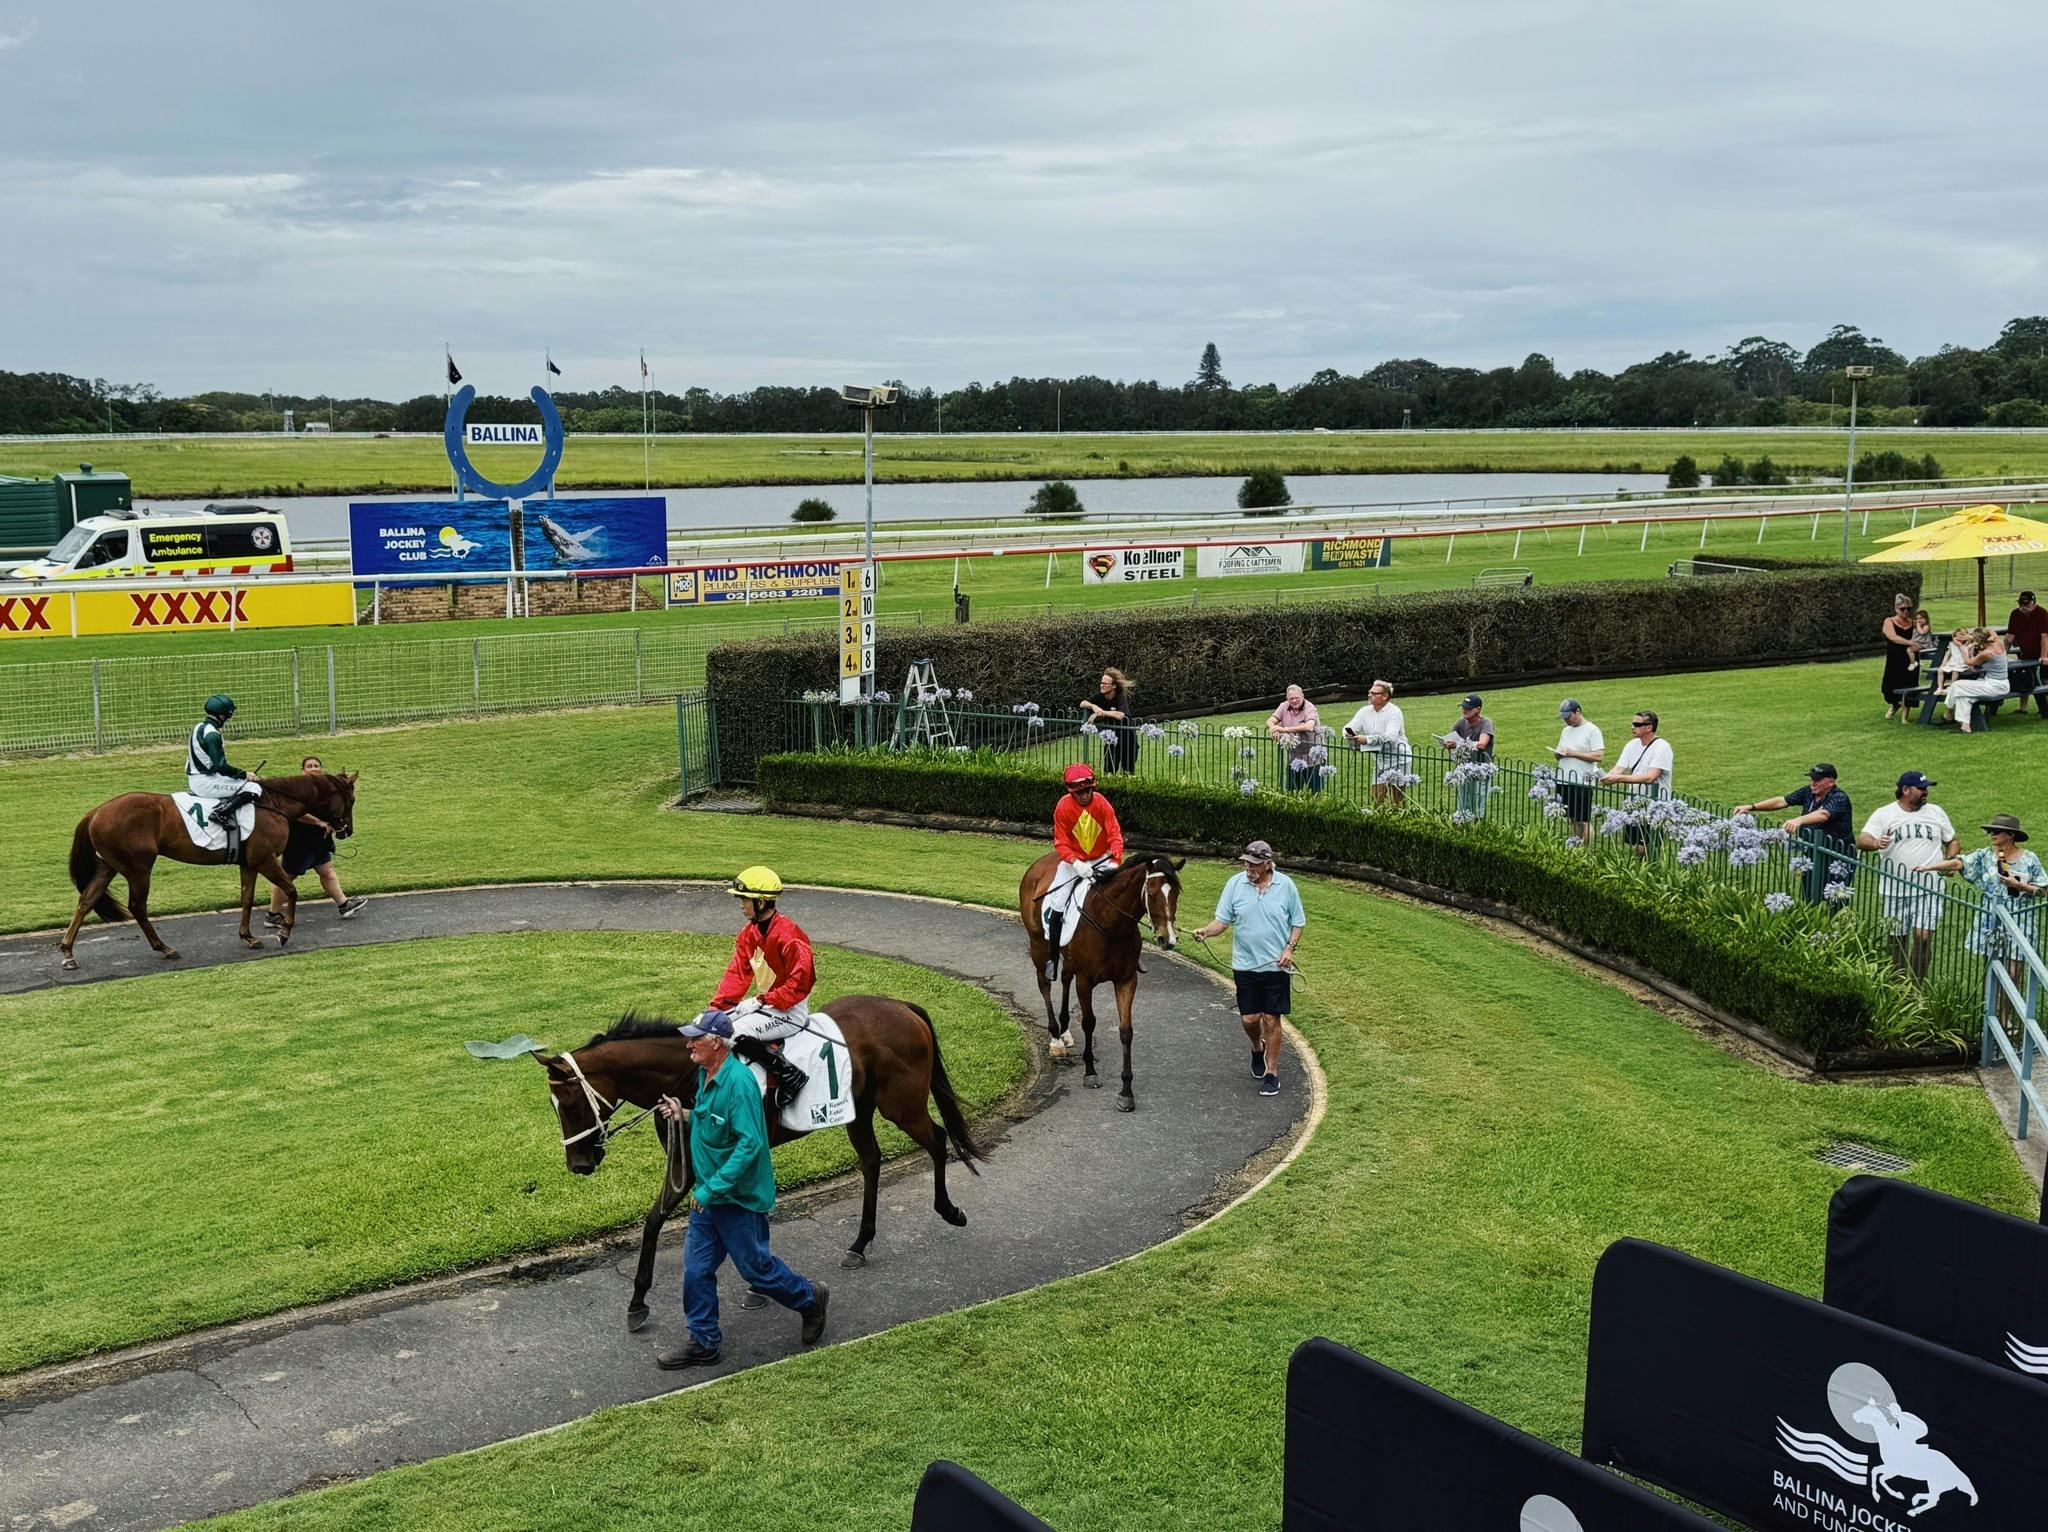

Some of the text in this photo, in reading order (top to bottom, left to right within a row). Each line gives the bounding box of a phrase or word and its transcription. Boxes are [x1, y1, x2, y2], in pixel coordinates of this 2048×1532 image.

[471, 426, 539, 442] BALLINA
[149, 532, 202, 544] Emergency
[379, 527, 426, 538] BALLINA
[151, 546, 203, 557] Ambulance
[384, 539, 426, 550] JOCKEY
[1323, 539, 1380, 551] RICHMOND
[399, 551, 427, 561] CLUB
[1124, 550, 1181, 565] Koellner
[1344, 549, 1380, 560] WASTE
[704, 564, 840, 582] MID RICHMOND
[865, 569, 871, 588] 6
[1124, 568, 1181, 580] STEEL
[674, 580, 692, 592] MRP
[704, 580, 766, 590] PLUMBERS
[785, 576, 840, 586] SUPPLIERS
[726, 588, 823, 600] 02 6683 2281
[130, 590, 248, 626] XXXX
[863, 597, 871, 615] 10
[866, 624, 871, 642] 9
[866, 650, 871, 668] 8
[1895, 824, 1933, 843] NIKE
[819, 1041, 839, 1099] 1
[1773, 1470, 1911, 1532] BALLINA JOCKE
[1773, 1493, 1865, 1532] AND FUN
